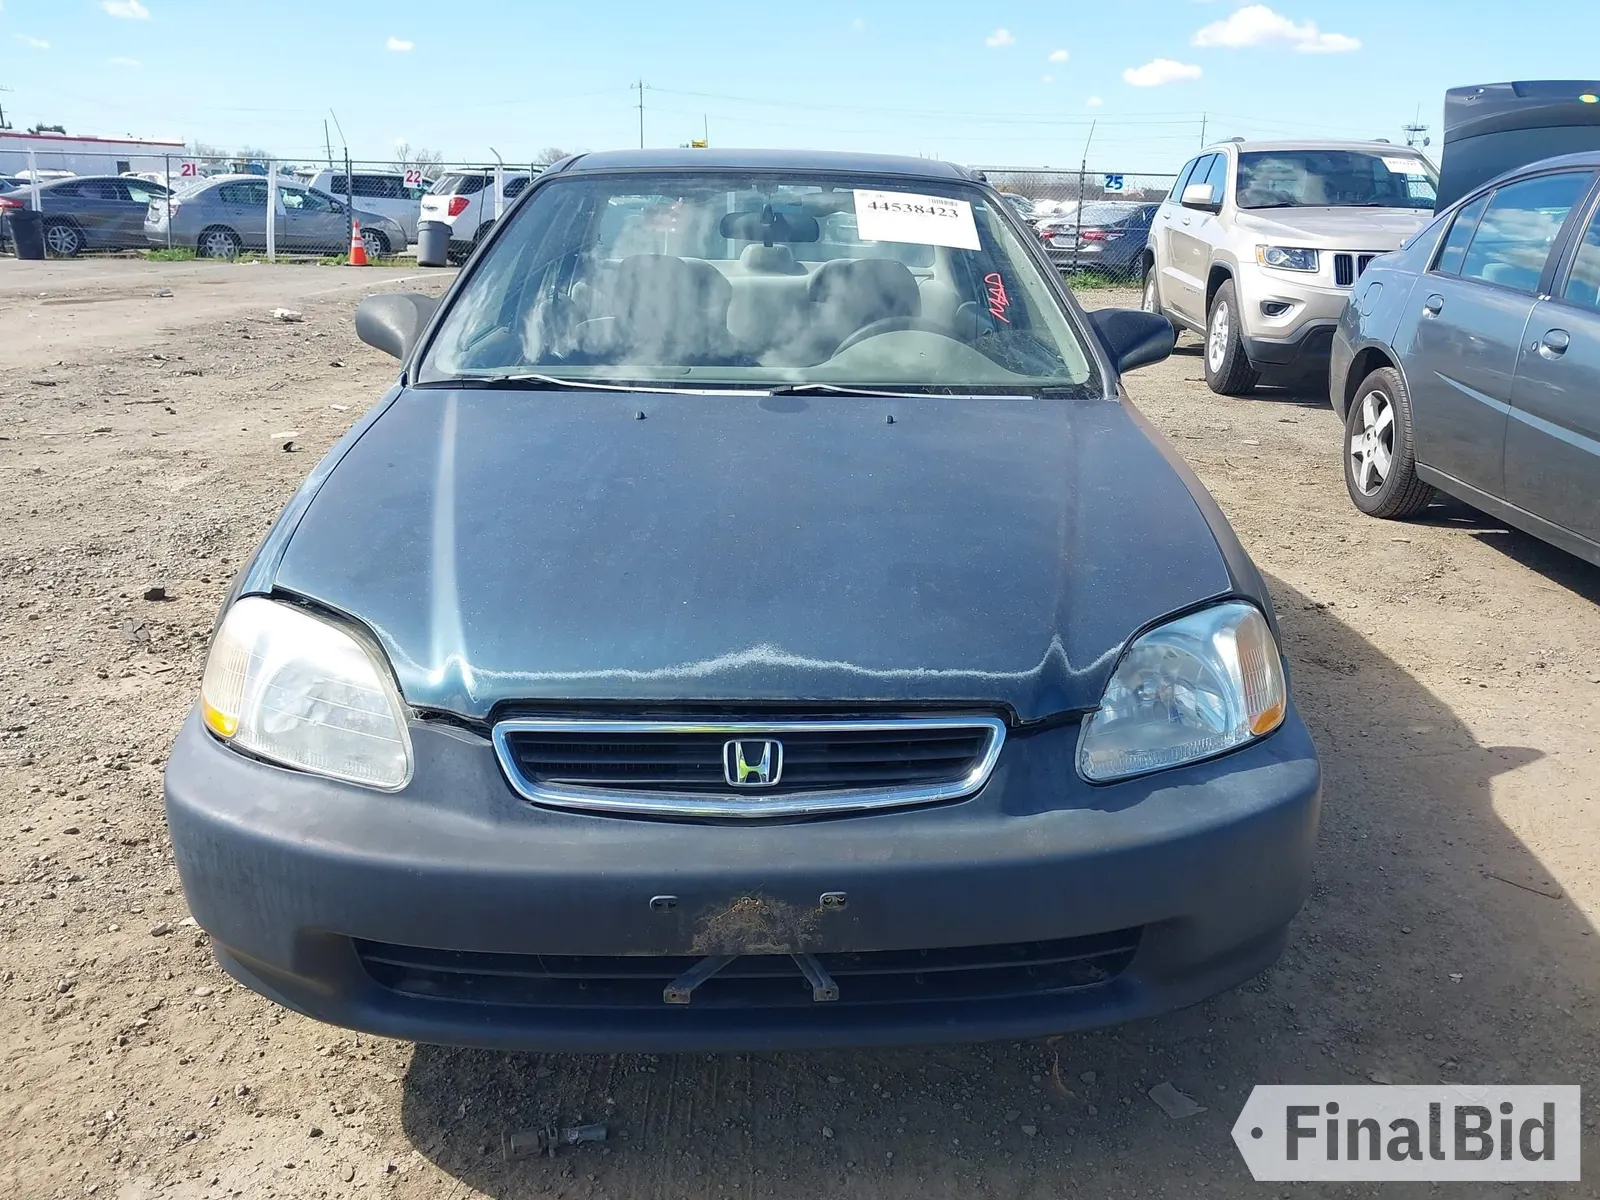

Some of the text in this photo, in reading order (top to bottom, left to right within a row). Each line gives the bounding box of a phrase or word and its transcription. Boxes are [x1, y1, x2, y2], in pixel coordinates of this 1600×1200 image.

[181, 164, 196, 176] 21
[406, 170, 421, 183] 22
[1105, 175, 1123, 190] 25
[867, 201, 959, 218] 44538423
